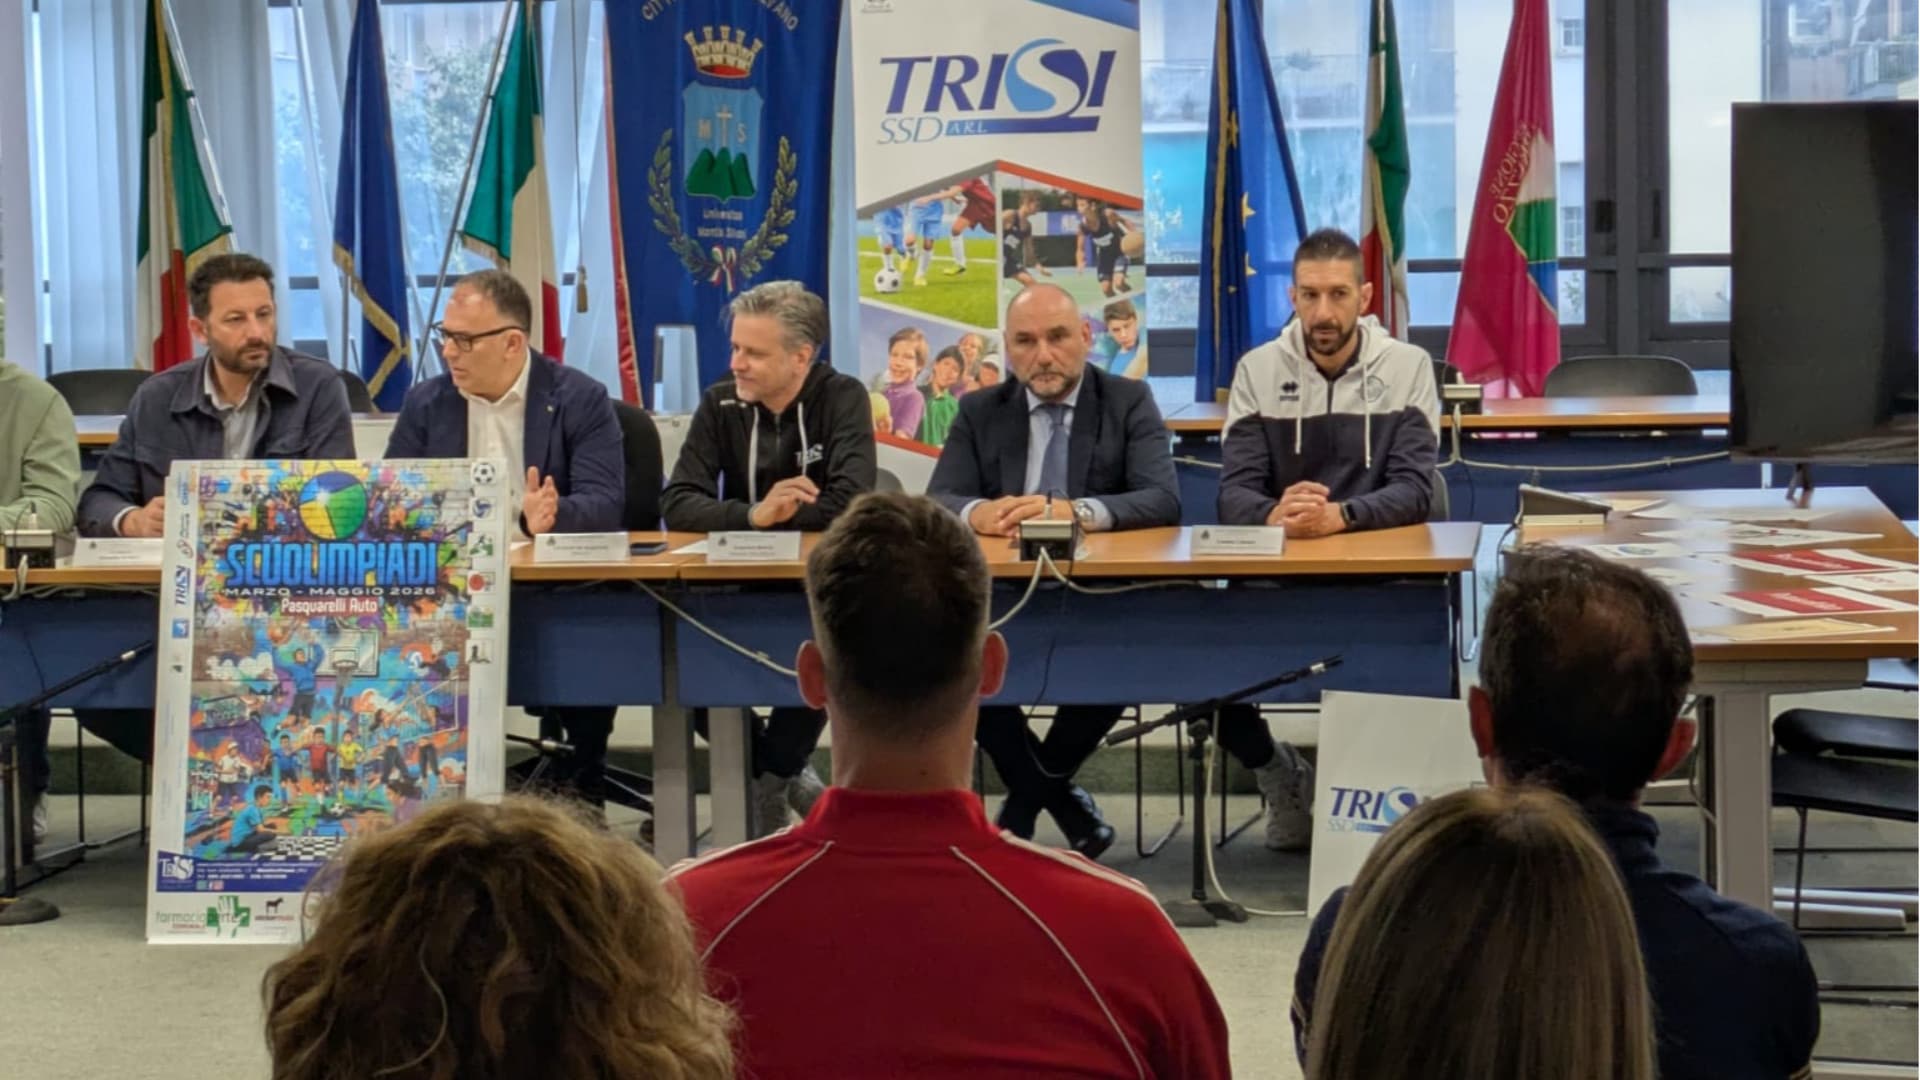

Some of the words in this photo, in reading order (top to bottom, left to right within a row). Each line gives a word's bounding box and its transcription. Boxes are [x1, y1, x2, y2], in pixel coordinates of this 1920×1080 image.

[880, 38, 1117, 117] TRISI
[877, 117, 943, 144] SSD
[227, 542, 436, 586] SCUOLIMPIADI
[224, 588, 290, 596] MARZO
[309, 587, 384, 596] MAGGIO
[390, 587, 436, 596] 2026
[281, 599, 346, 615] Pasquarelli
[349, 598, 378, 613] Auto
[1330, 786, 1428, 824] TRIS
